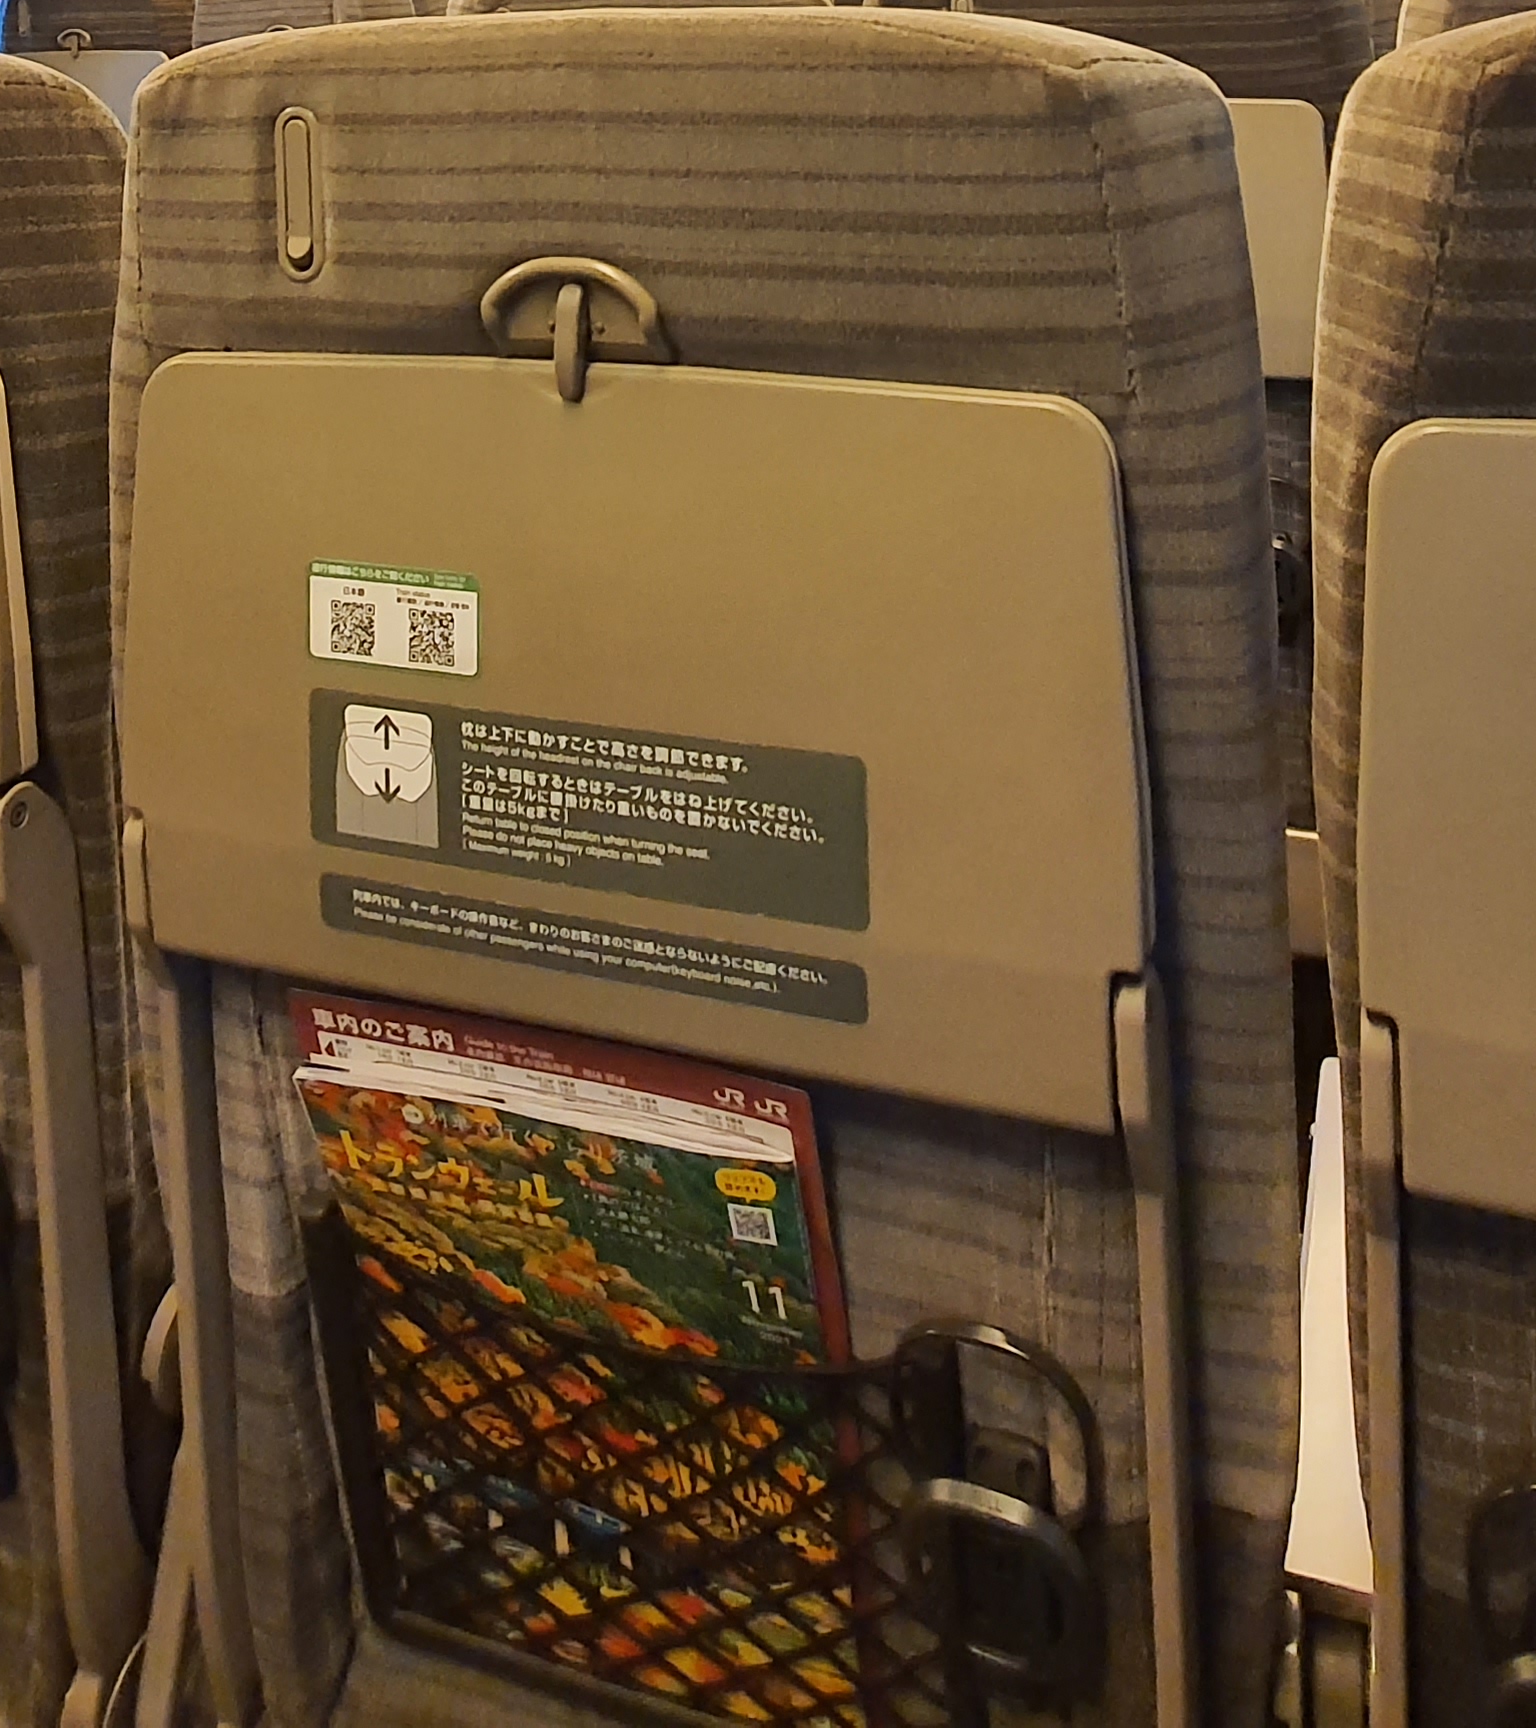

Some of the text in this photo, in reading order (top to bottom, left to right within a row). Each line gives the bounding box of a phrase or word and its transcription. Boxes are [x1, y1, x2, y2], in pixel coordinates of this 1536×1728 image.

[311, 1007, 454, 1052] 車内のご案内
[713, 1086, 788, 1119] JR JR
[742, 1280, 787, 1321] 11
